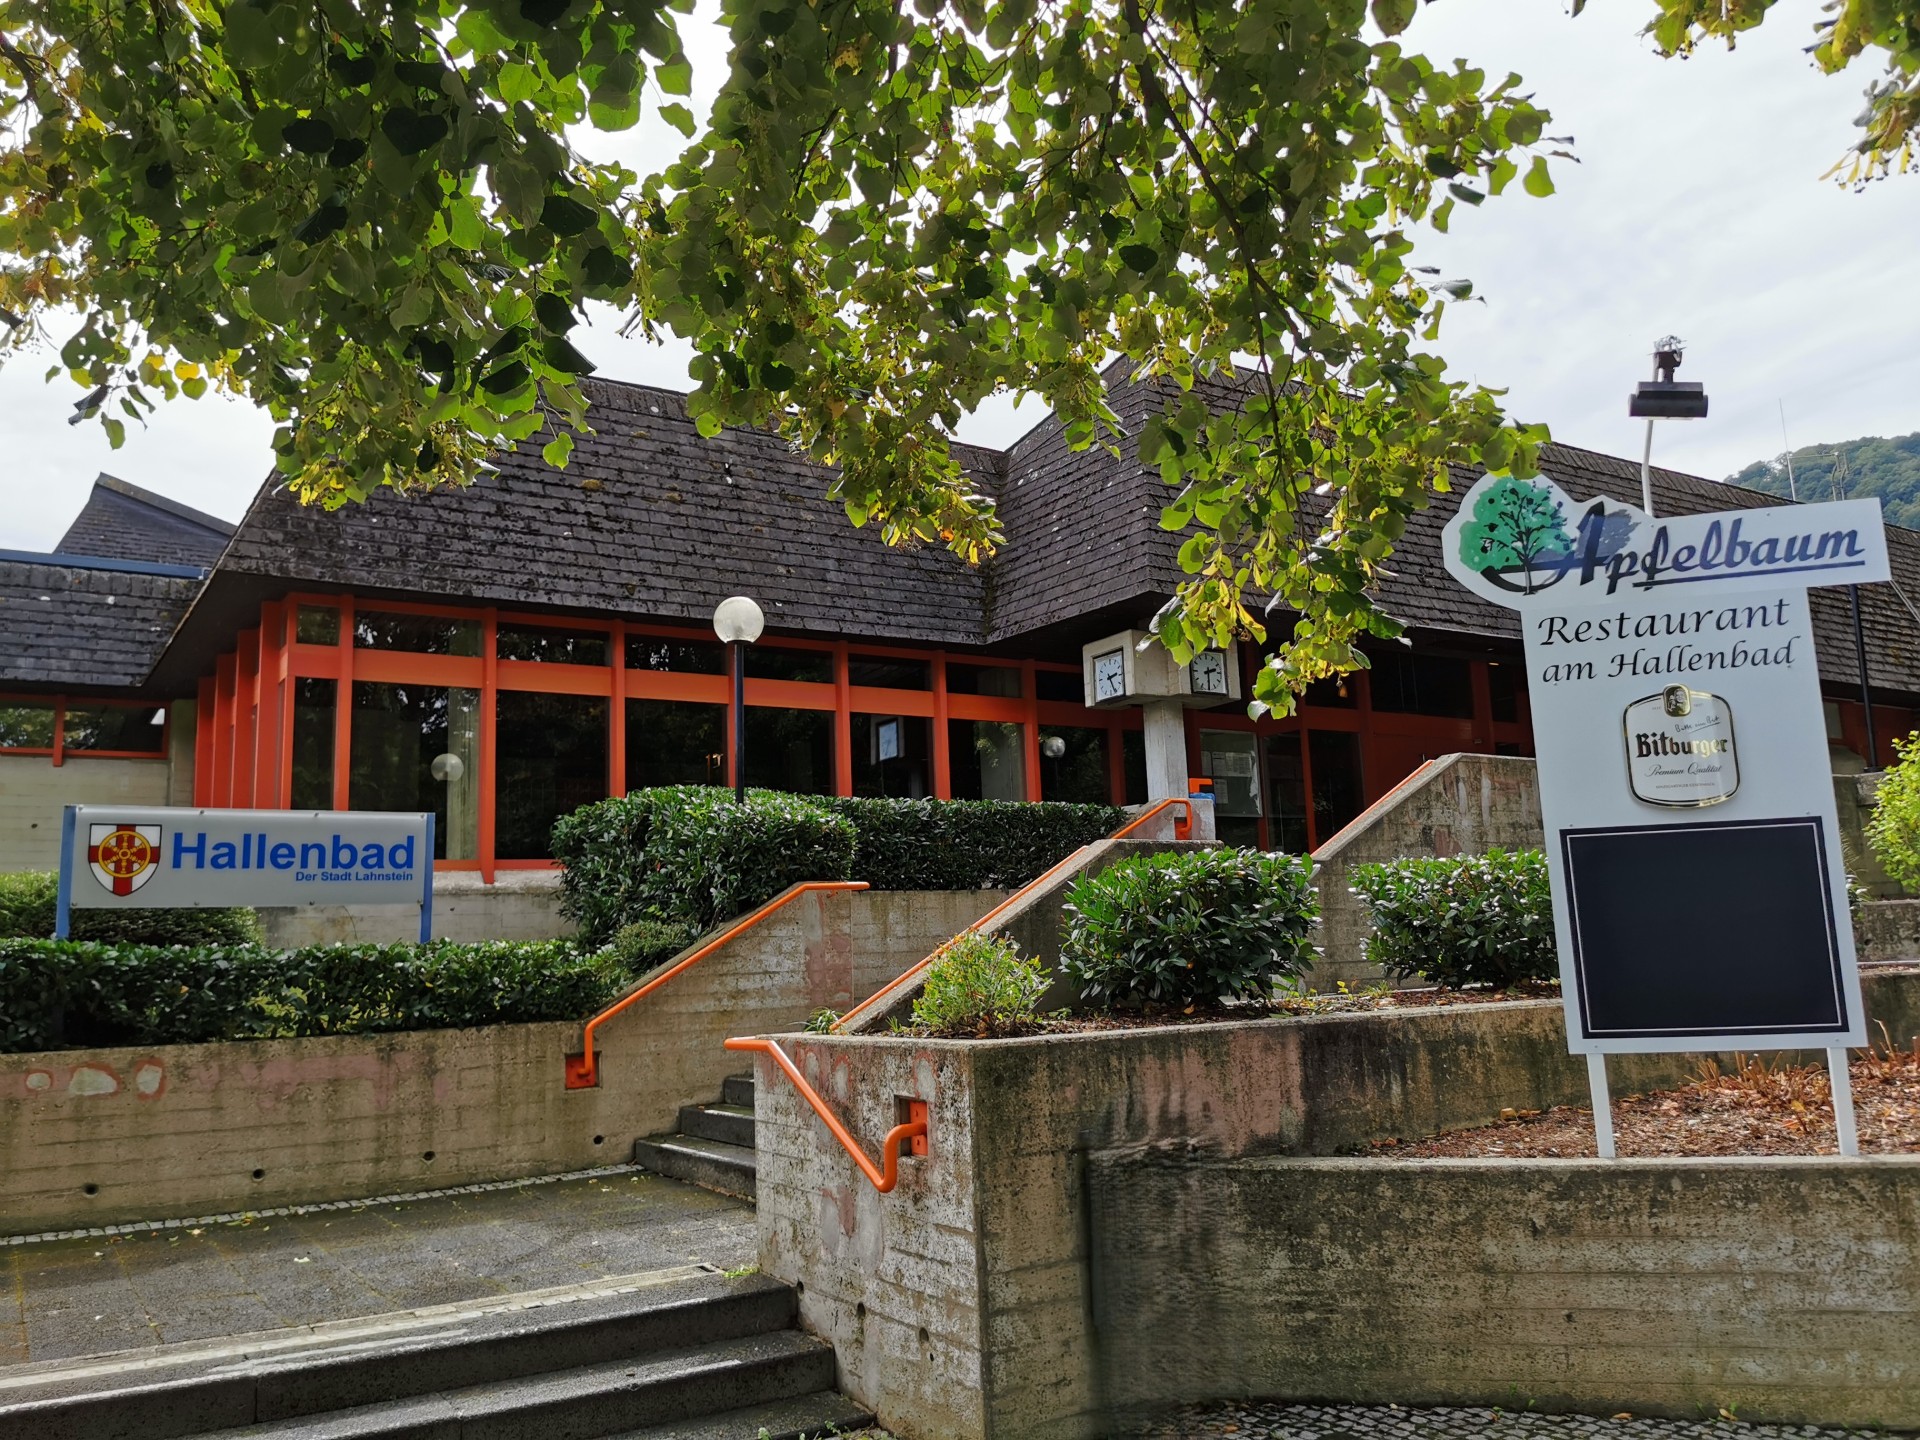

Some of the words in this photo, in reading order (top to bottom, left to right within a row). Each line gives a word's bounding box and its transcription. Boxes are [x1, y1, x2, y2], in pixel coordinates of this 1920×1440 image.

[1553, 500, 1866, 595] Apfelbaum
[1537, 598, 1791, 646] Restaurant
[1542, 659, 1598, 683] am
[1607, 635, 1801, 679] Hallenbad
[1635, 731, 1728, 758] Bitburger
[1645, 764, 1684, 777] Premium
[172, 832, 415, 870] Hallenbad
[295, 871, 318, 882] Der
[321, 871, 352, 882] Stadt
[355, 871, 413, 882] Lahnstein
